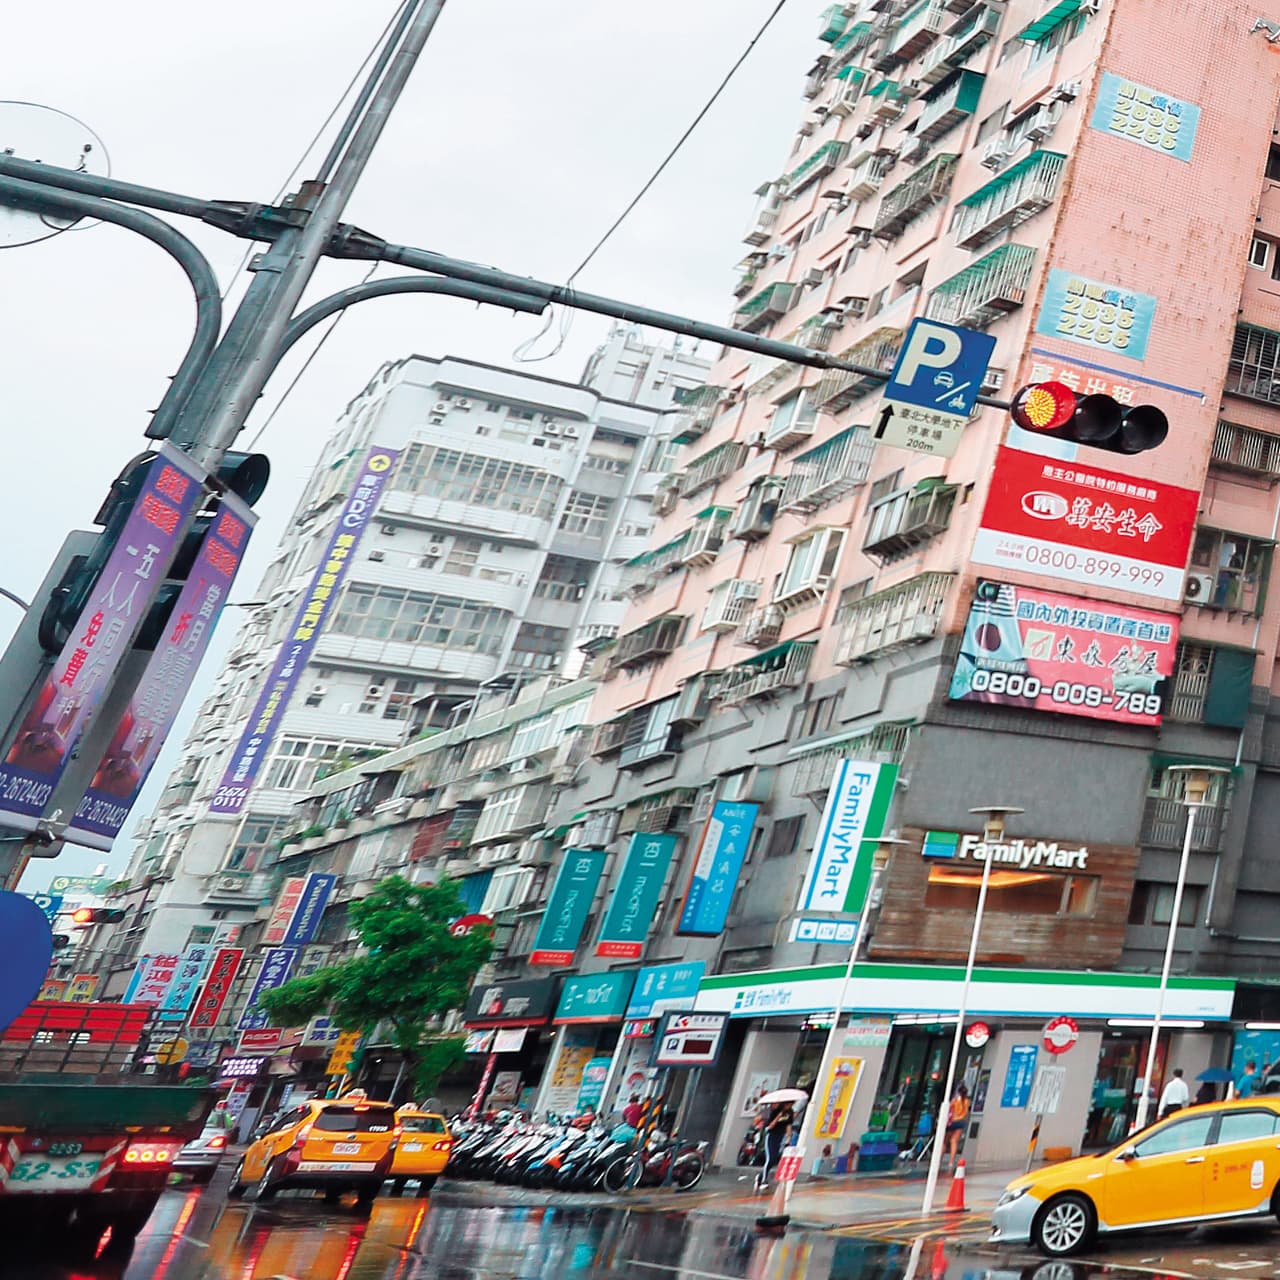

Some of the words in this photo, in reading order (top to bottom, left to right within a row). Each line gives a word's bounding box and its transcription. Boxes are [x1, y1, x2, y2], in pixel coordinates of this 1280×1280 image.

[894, 322, 962, 387] P
[906, 438, 934, 452] 200m
[907, 424, 942, 441] 停車場
[1066, 497, 1162, 542] 萬安生命
[1025, 545, 1164, 587] 0800-899-999
[1054, 636, 1158, 672] 東森房屋
[971, 671, 1161, 715] 0800-009-789
[821, 772, 871, 900] FamilyMart
[960, 835, 1088, 868] FamilyMart
